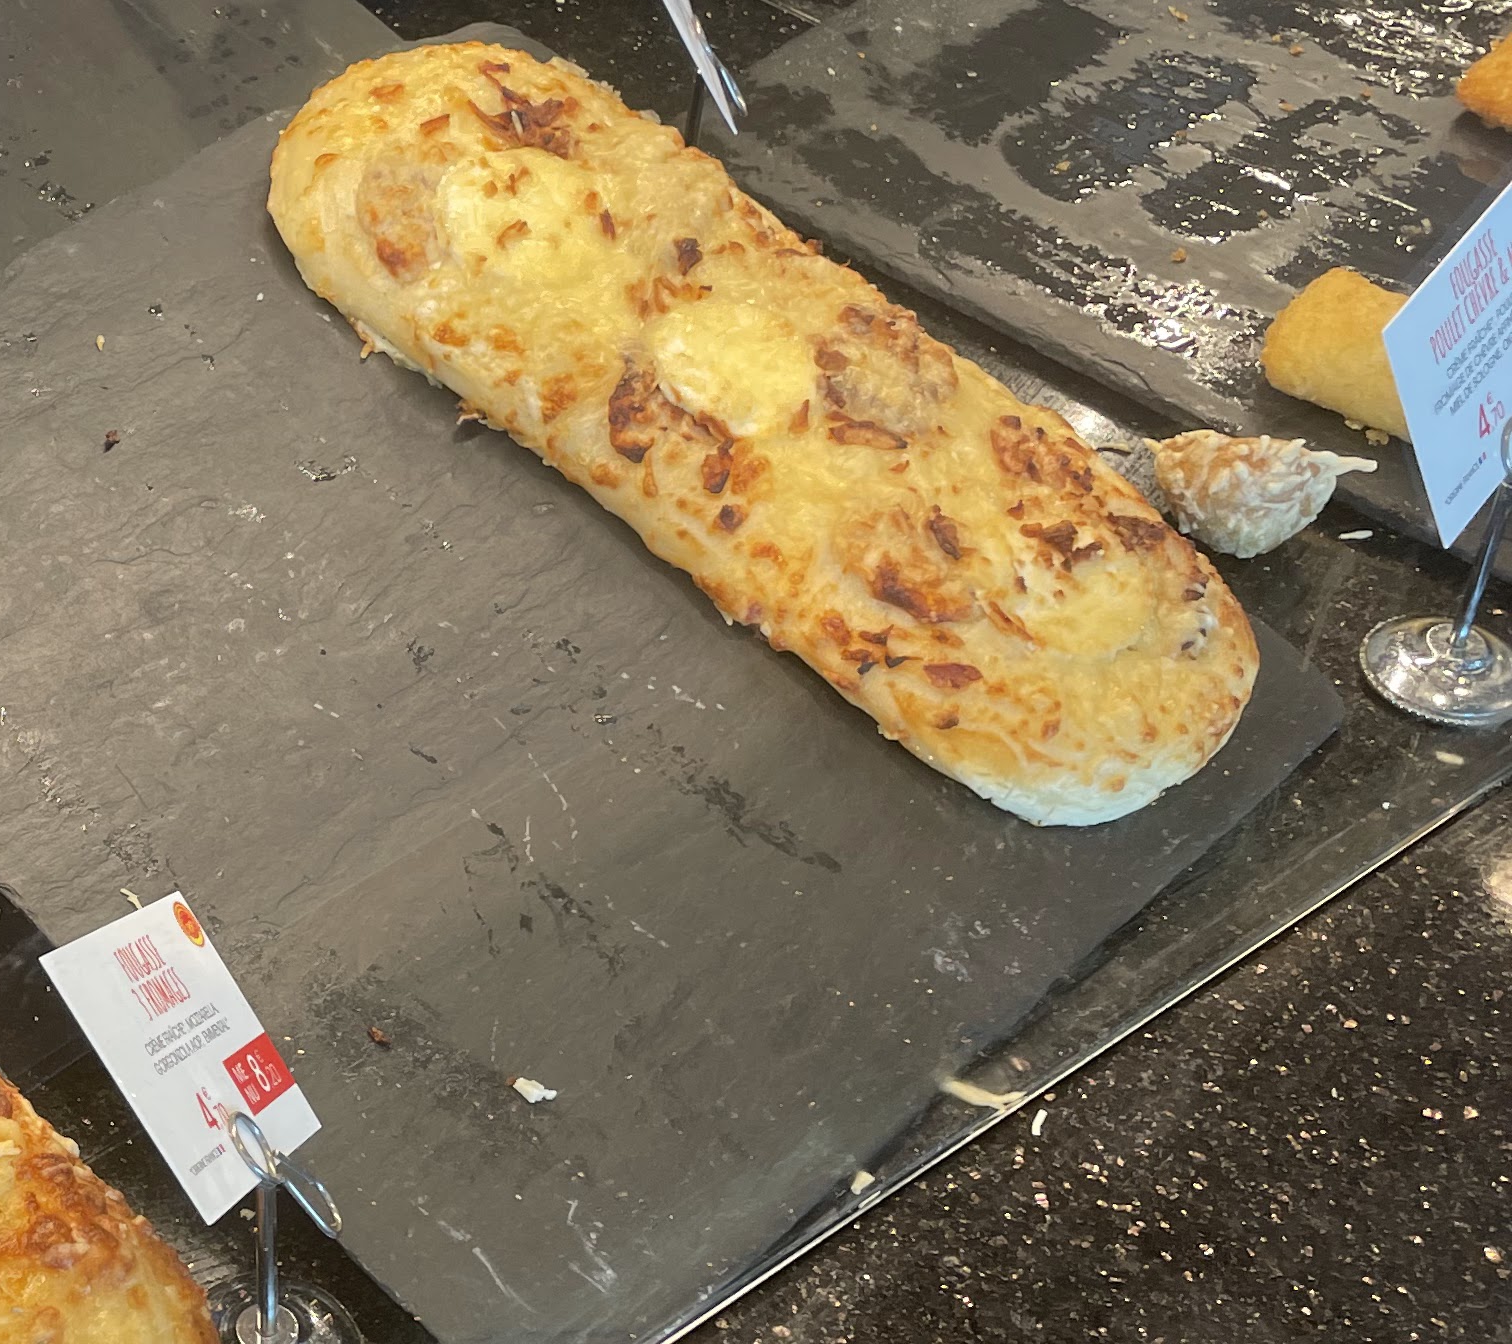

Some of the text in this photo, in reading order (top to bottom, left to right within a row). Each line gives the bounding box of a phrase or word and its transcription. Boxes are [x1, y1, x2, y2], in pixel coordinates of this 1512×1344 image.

[1449, 229, 1497, 300] FOUGASSE
[1429, 304, 1466, 365] POULET
[113, 935, 166, 982] FOUGASSE
[130, 967, 191, 1022] 3 FROMAGES
[231, 1062, 250, 1083] ME
[244, 1084, 261, 1104] NU
